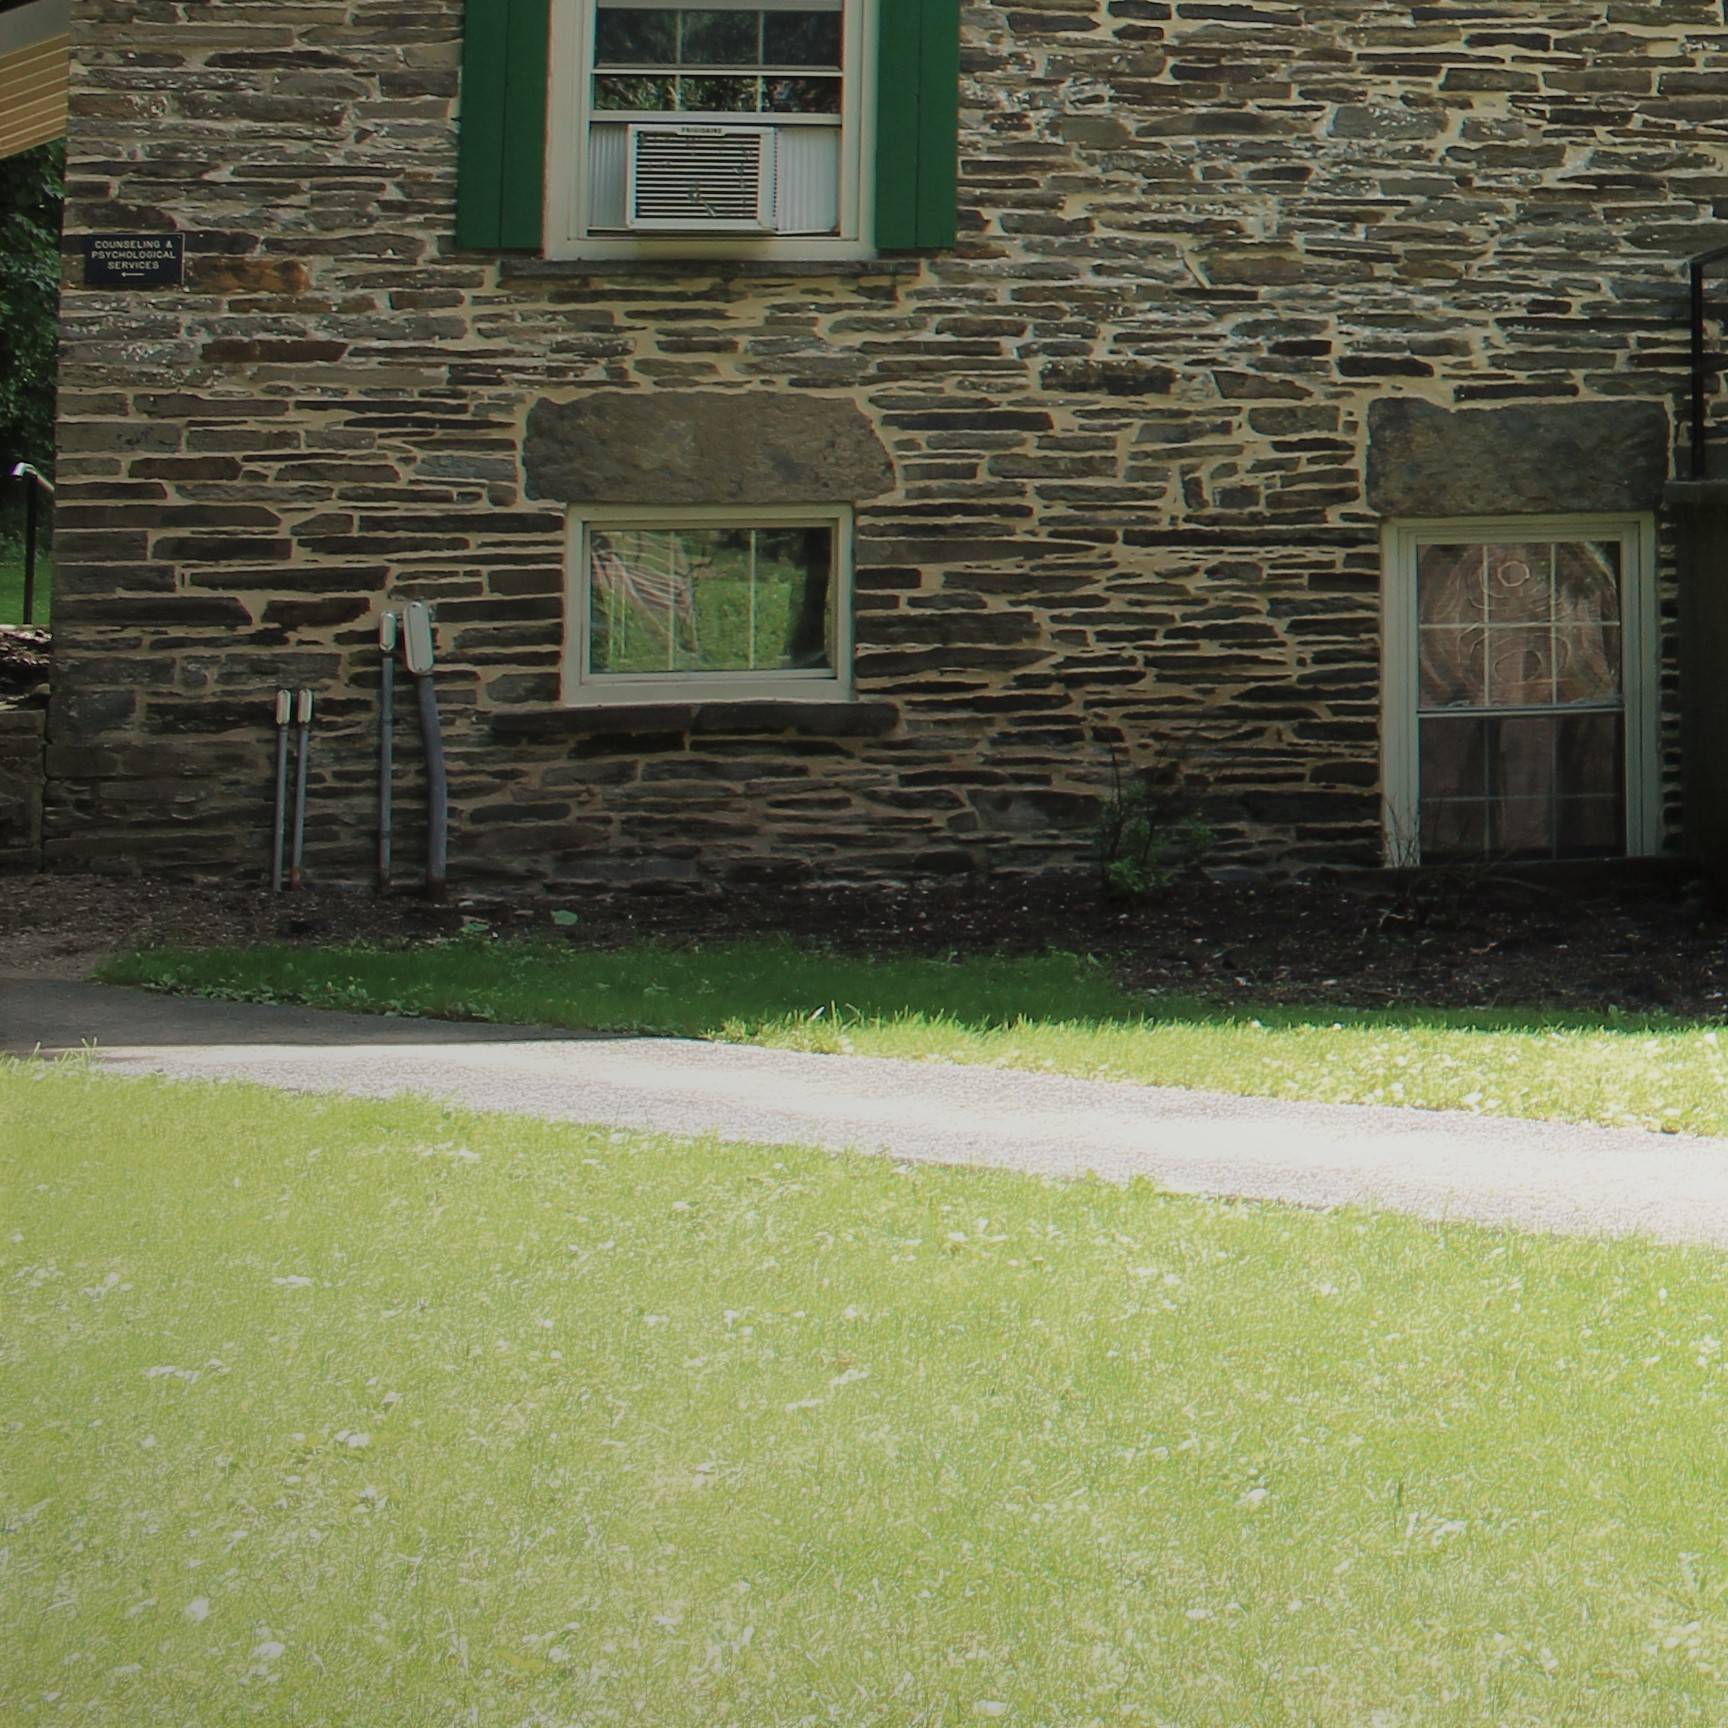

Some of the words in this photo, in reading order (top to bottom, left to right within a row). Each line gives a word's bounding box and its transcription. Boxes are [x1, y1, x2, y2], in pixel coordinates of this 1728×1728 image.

[94, 240, 161, 249] COUNSELING
[91, 251, 177, 259] PSYCHOLOGICAL
[107, 261, 160, 270] SERVICES
